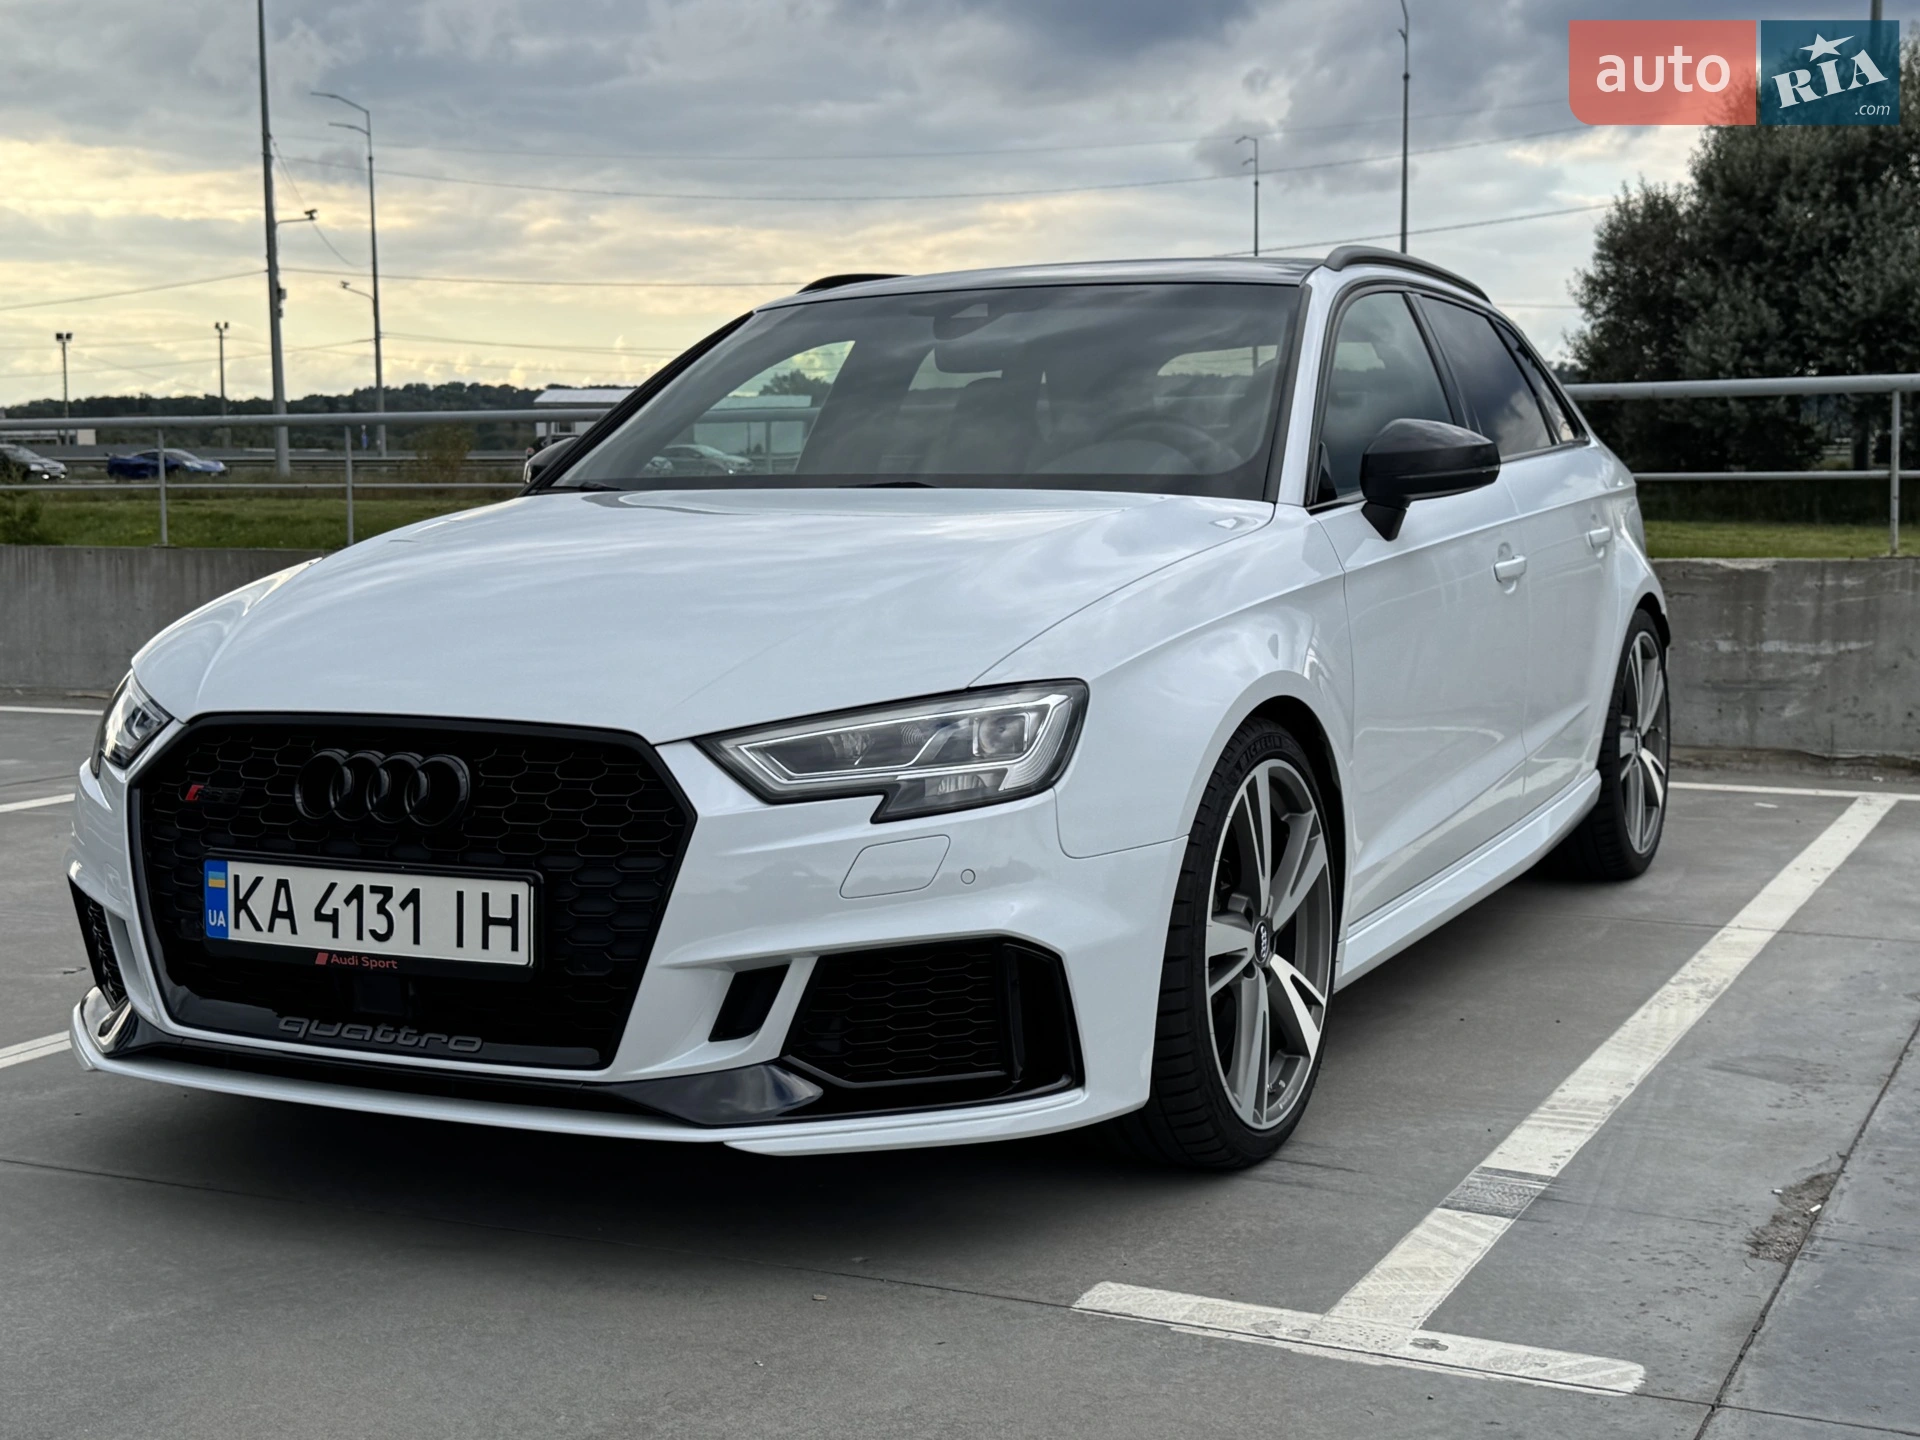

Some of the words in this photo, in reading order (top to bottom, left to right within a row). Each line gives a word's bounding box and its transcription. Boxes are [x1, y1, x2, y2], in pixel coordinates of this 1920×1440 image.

[208, 909, 227, 928] UA
[233, 873, 298, 935] KA
[314, 881, 421, 946] 4131
[456, 890, 519, 952] IH
[330, 954, 359, 966] Audi
[361, 956, 398, 970] Sport
[278, 1015, 483, 1053] quattro
